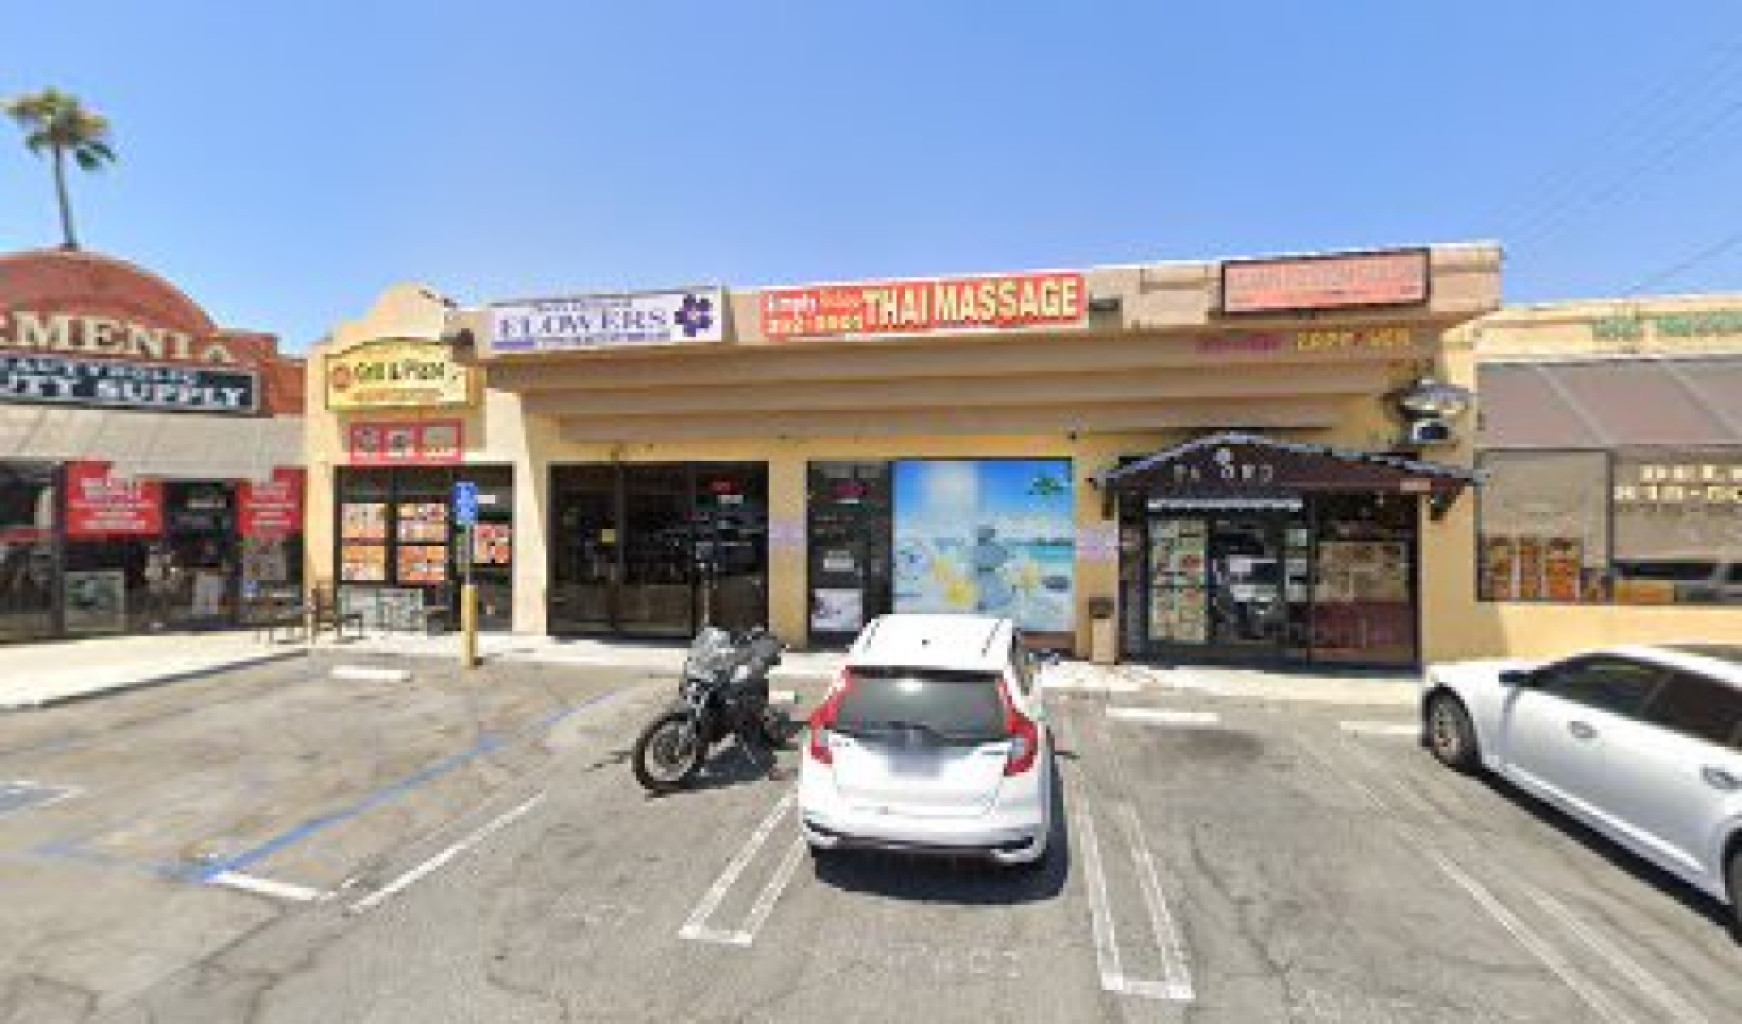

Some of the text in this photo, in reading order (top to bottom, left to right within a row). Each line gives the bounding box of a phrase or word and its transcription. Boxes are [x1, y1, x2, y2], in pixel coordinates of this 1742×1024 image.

[862, 281, 928, 326] THAI
[935, 277, 1079, 321] MASSAGE
[499, 306, 669, 337] FLOWERS
[97, 379, 246, 407] SUPPLY
